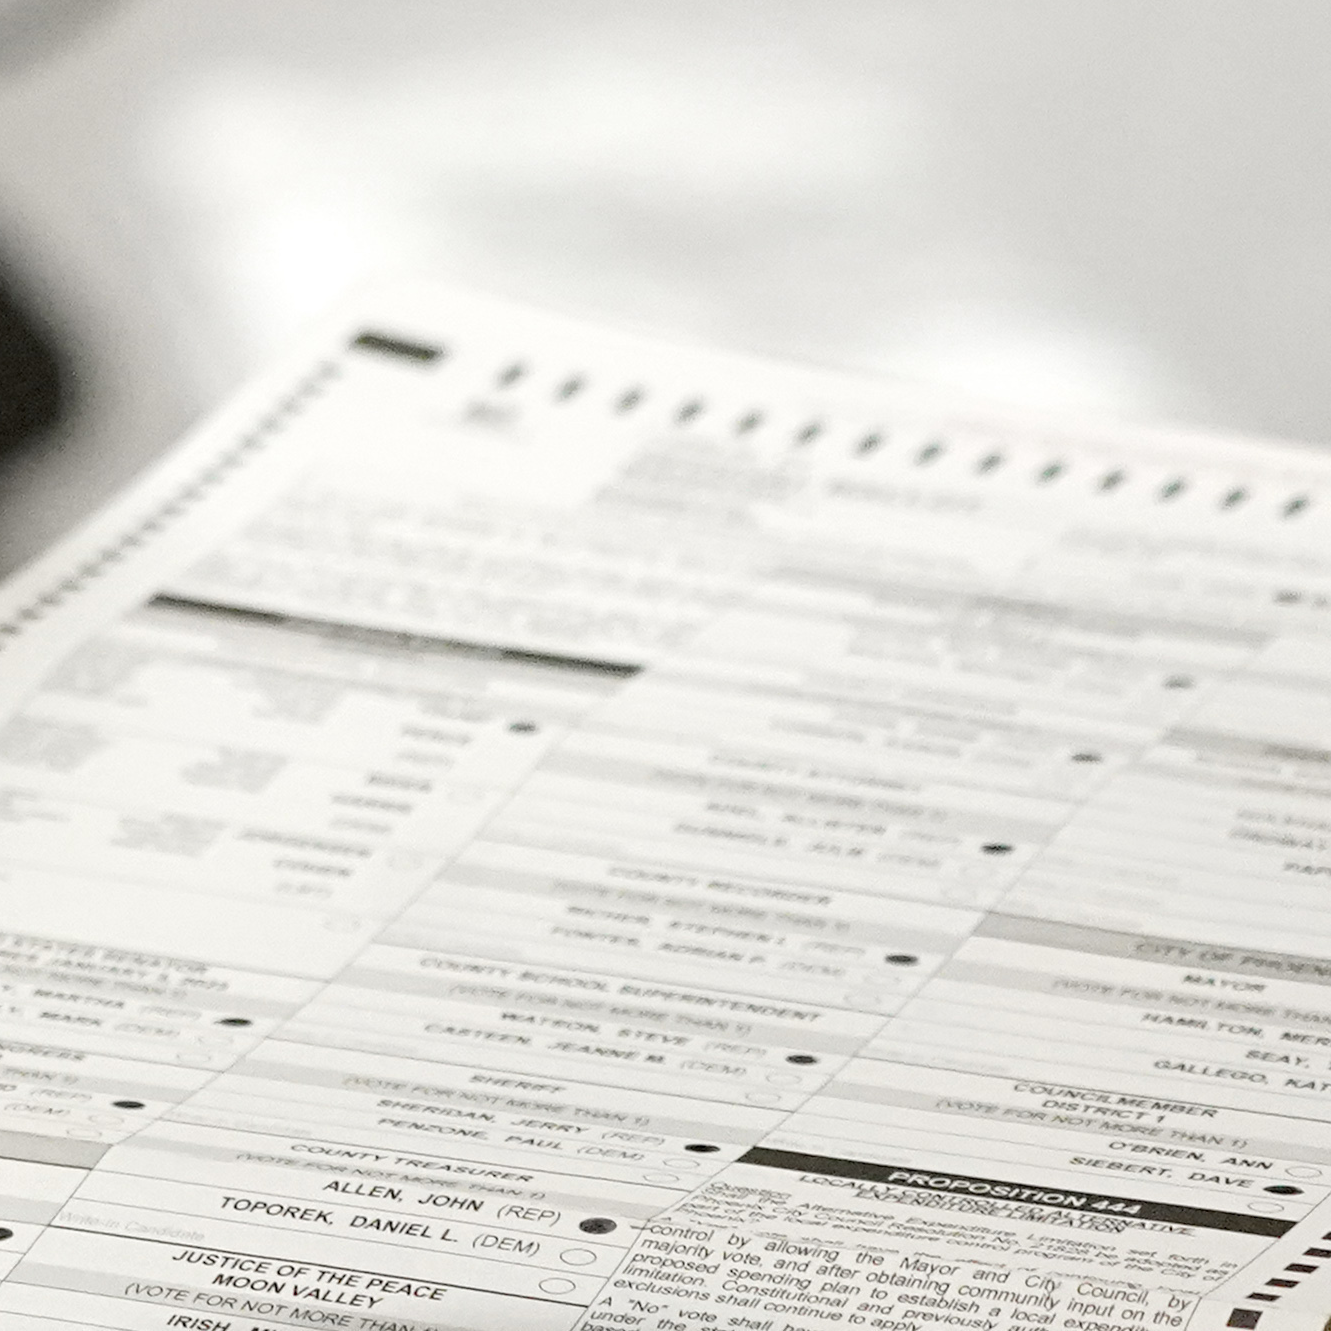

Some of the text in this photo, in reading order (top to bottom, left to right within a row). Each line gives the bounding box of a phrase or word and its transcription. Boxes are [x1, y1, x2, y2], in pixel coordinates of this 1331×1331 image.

[1013, 1081, 1219, 1118] COUNCILMEMBER
[1041, 1099, 1149, 1120] DISTRICT
[290, 1144, 535, 1183] COUNTY TREASURER
[1068, 1156, 1255, 1189] SIEBERT, DAVE
[1108, 1140, 1274, 1170] O'BRIEN, ANN
[322, 1180, 562, 1228] ALLEN, JOHN (REP)
[887, 1165, 1142, 1215] PROPOSITION 444
[219, 1195, 542, 1258] TOPOREK, DANIEL L. (DEM)
[172, 1250, 448, 1301] JUSTICE OF THE PEACE
[639, 1237, 1185, 1330] majority vote, and after obtaining community input on the
[650, 1223, 1194, 1313] control by allowing the Mayor and City Council, by
[211, 1273, 384, 1309] MOON VALLEY
